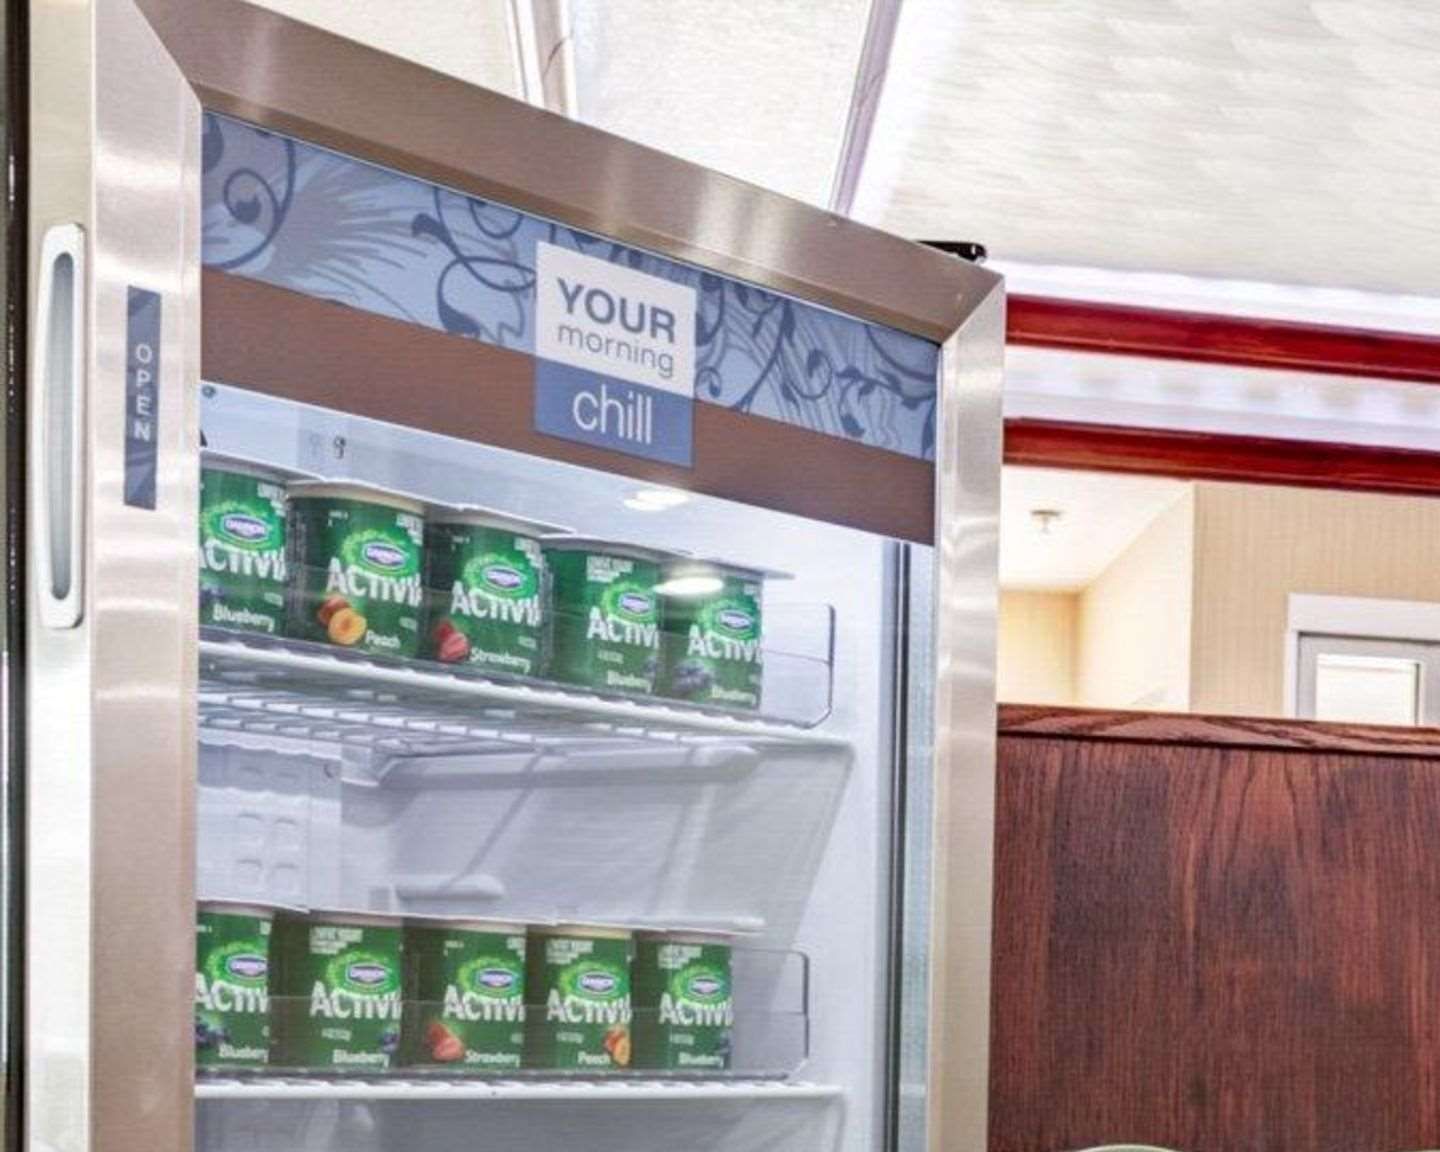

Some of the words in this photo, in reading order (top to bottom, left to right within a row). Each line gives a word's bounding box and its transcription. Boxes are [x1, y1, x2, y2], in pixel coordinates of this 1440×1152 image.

[557, 277, 676, 343] YOUR
[557, 323, 674, 378] morning
[134, 344, 153, 441] OPEN
[573, 384, 652, 444] chill
